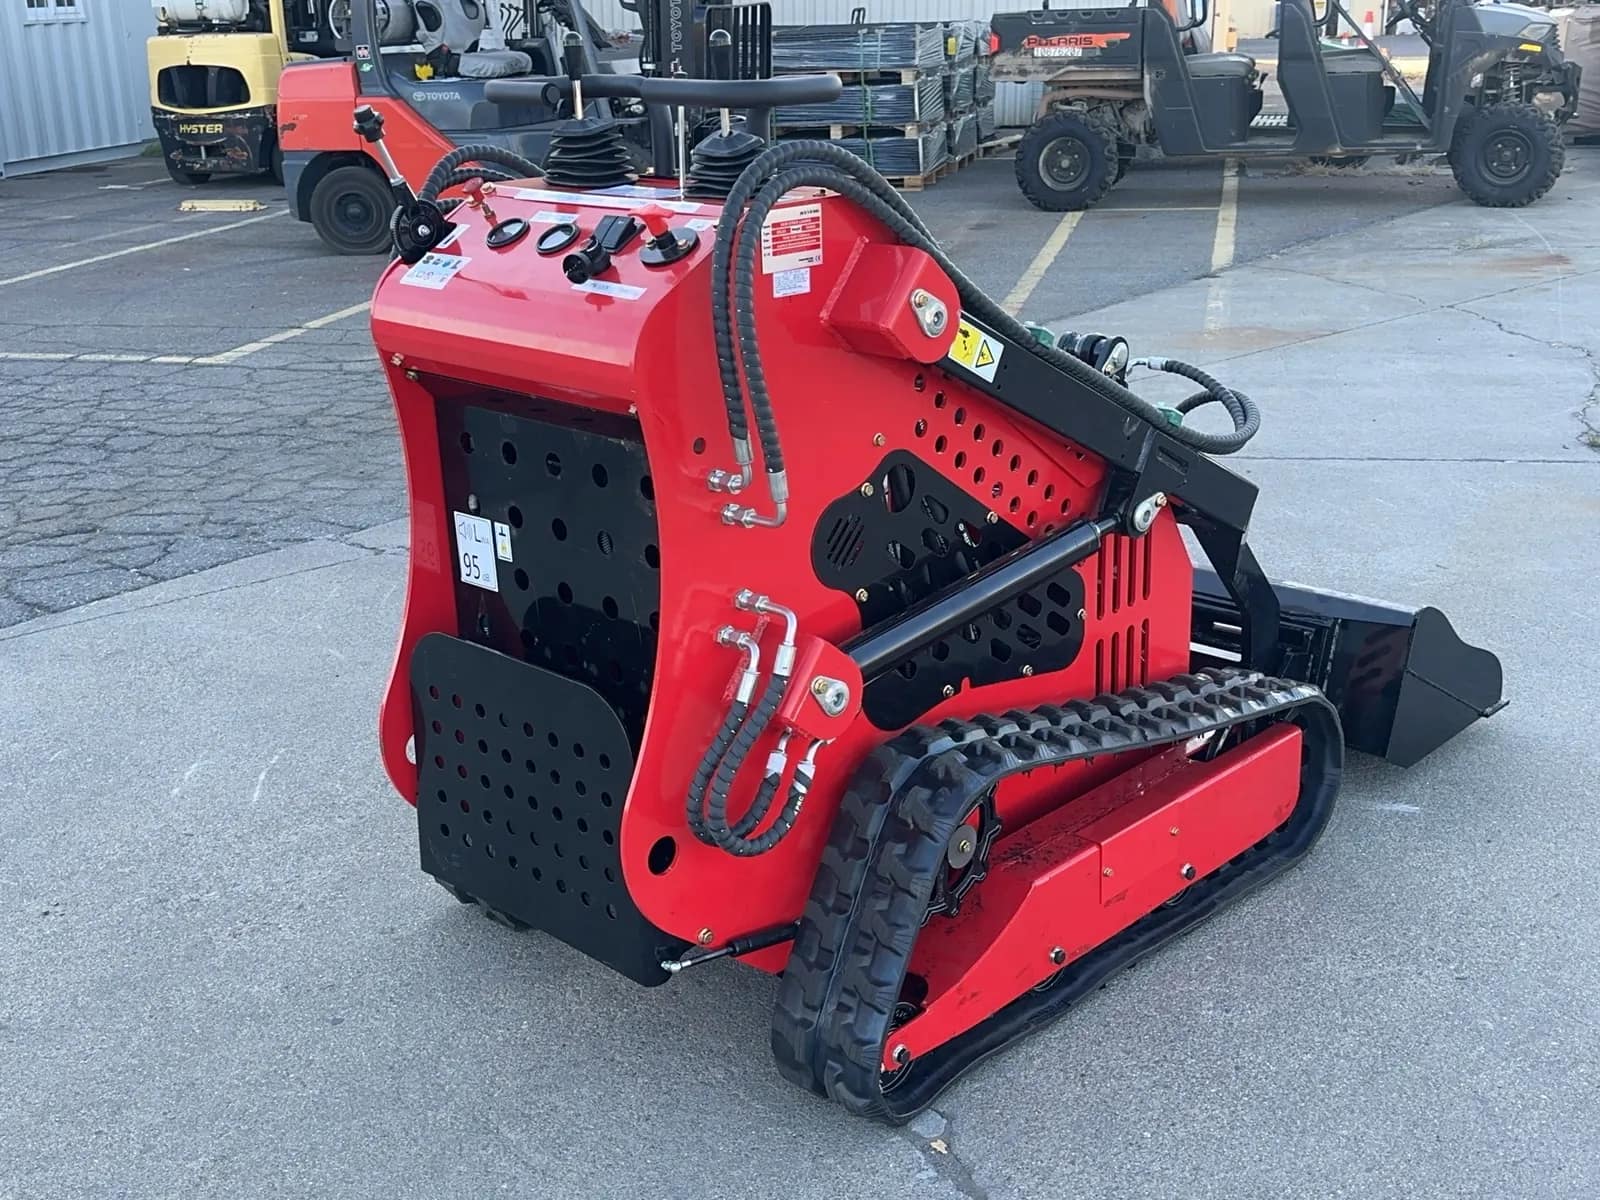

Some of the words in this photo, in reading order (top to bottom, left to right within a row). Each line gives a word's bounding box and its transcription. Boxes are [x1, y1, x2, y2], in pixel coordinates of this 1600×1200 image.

[1027, 36, 1094, 46] POLARIS
[425, 91, 461, 101] TOYOTA
[179, 124, 224, 134] HYSTER
[463, 552, 481, 580] 95
